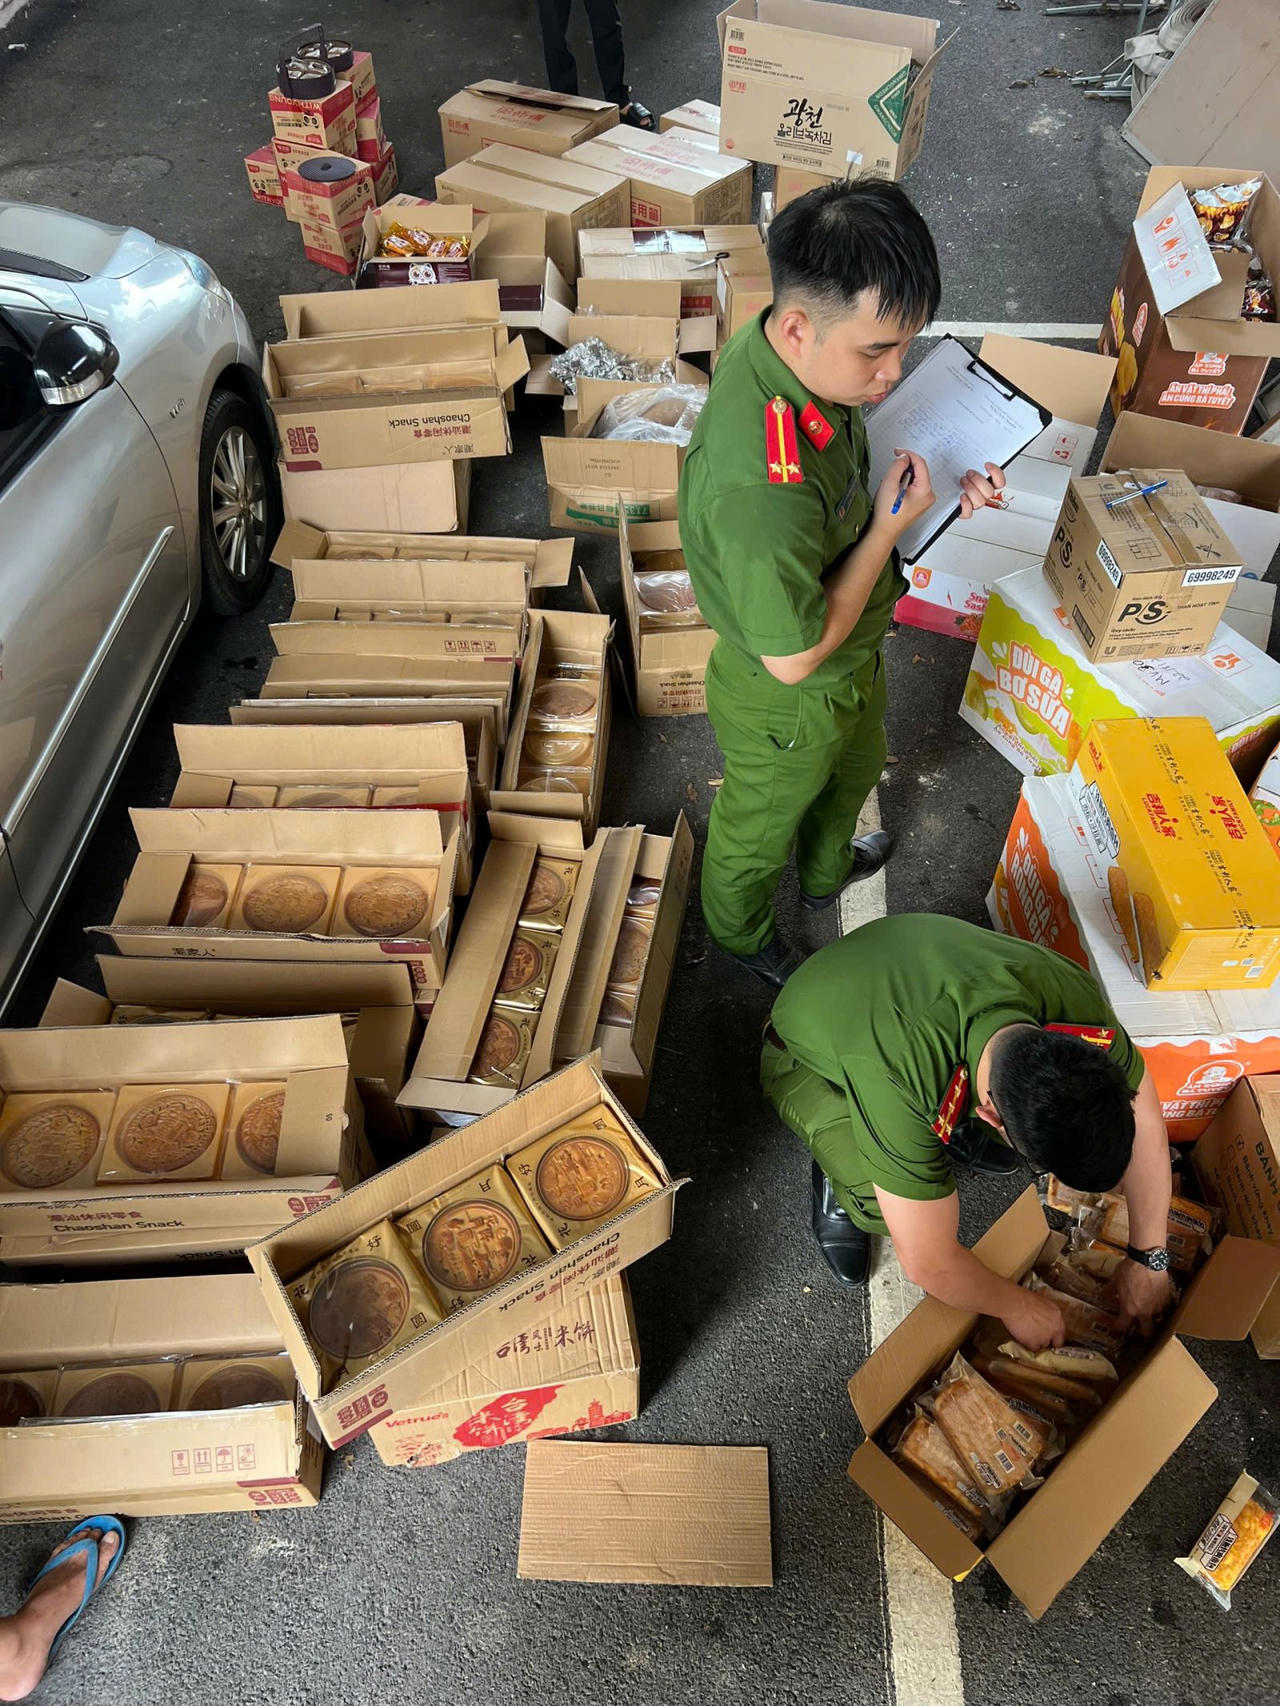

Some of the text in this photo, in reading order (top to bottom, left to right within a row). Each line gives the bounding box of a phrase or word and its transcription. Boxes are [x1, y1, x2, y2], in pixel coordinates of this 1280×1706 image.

[783, 98, 823, 128] 광천
[388, 413, 471, 429] Chaoshan Snack
[1187, 568, 1236, 584] 69998249
[53, 1219, 185, 1233] Chaoshan Snack
[498, 1232, 621, 1312] Chaoshan Snack
